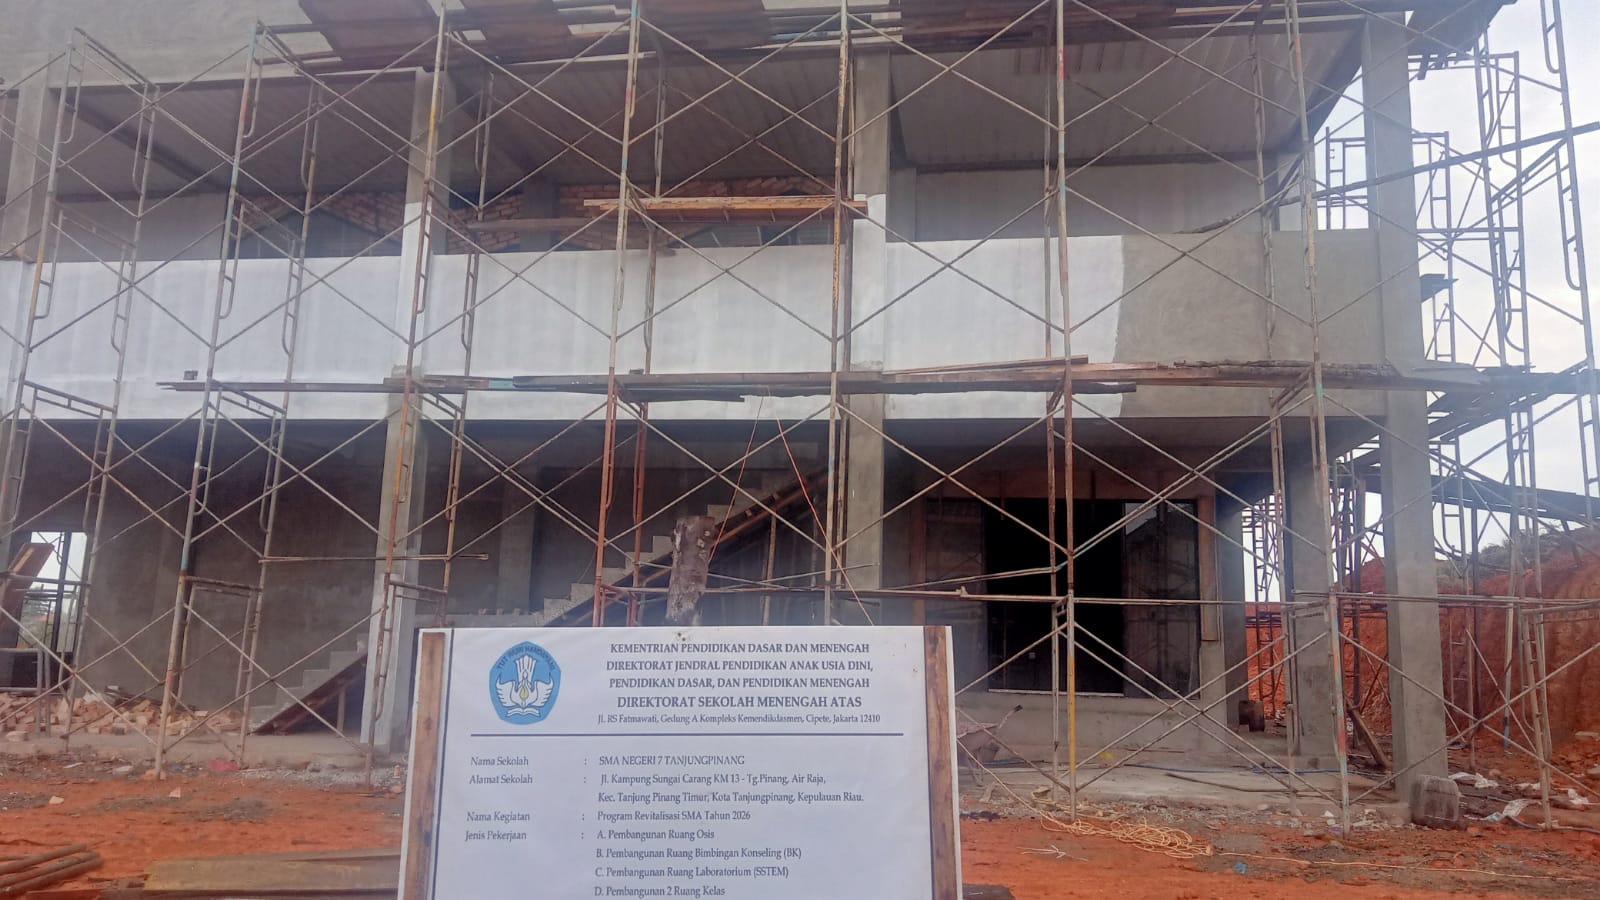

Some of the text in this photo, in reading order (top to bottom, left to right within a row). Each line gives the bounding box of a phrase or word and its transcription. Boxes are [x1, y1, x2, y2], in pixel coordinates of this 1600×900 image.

[610, 643, 870, 653] KEMENTRIAN PENDIDIKAN DASAR DAN MENENGAH
[497, 655, 509, 670] TUT
[606, 660, 874, 672] DIREKTORAT JENDRAL PENDIDIKAN ANAK USIA DINI,
[609, 678, 870, 689] PENDIDIKAN DASAR, DAN PENDIDIKAN MENENGAH
[617, 696, 862, 708] DIREKTORAT SEKOLAH MENENGAH ATAS
[607, 714, 618, 722] RS
[660, 714, 690, 725] Gedung
[691, 714, 698, 722] A
[699, 714, 736, 725] Kompleks
[806, 714, 832, 725] Cipete,
[832, 714, 858, 724] Jakarta
[860, 714, 881, 722] 12410
[470, 756, 496, 766] Nama
[496, 756, 529, 766] Sekolah
[599, 756, 620, 765] SMA
[622, 756, 656, 765] NEGERI
[657, 756, 663, 765] 7
[664, 756, 745, 766] TANJUNGPINANG
[469, 774, 500, 784] Alamat
[500, 774, 533, 784] Sekolah
[600, 774, 609, 786] Jl.
[611, 774, 652, 786] Kampung
[652, 774, 680, 785] Sungai
[682, 774, 712, 785] Carang
[713, 774, 728, 783] KM
[730, 774, 740, 783] 13
[791, 774, 805, 783] Air
[806, 774, 826, 786] Raja,
[598, 792, 615, 802] Kec.
[617, 792, 650, 804] Tanjung
[652, 792, 680, 804] Pinang
[712, 792, 730, 802] Kota
[797, 792, 841, 804] Kepulauan
[842, 792, 864, 802] Riau.
[466, 812, 492, 821] Nama
[493, 811, 530, 823] Kegiatan
[597, 812, 633, 823] Program
[634, 810, 680, 820] Revitalisasi
[681, 811, 702, 820] SMA
[704, 811, 730, 820] Tahun
[732, 812, 751, 820] 2026
[465, 830, 486, 842] Jenis
[486, 830, 526, 842] Pekerjaan
[596, 830, 606, 839] A.
[608, 830, 666, 842] Pembangunan
[668, 830, 695, 842] Ruang
[696, 829, 714, 839] Osis
[606, 848, 664, 860] Pembangunan
[666, 848, 693, 860] Ruang
[695, 848, 739, 860] Bimbingan
[740, 848, 782, 860] Konseling
[783, 848, 802, 860] (BK)
[606, 867, 665, 879] Pembangunan
[667, 867, 694, 879] Ruang
[695, 866, 752, 876] Laboratorium
[754, 866, 789, 878] (SSTEM)
[594, 886, 725, 898] D. Pembangunan 2 Ruang Kelas
